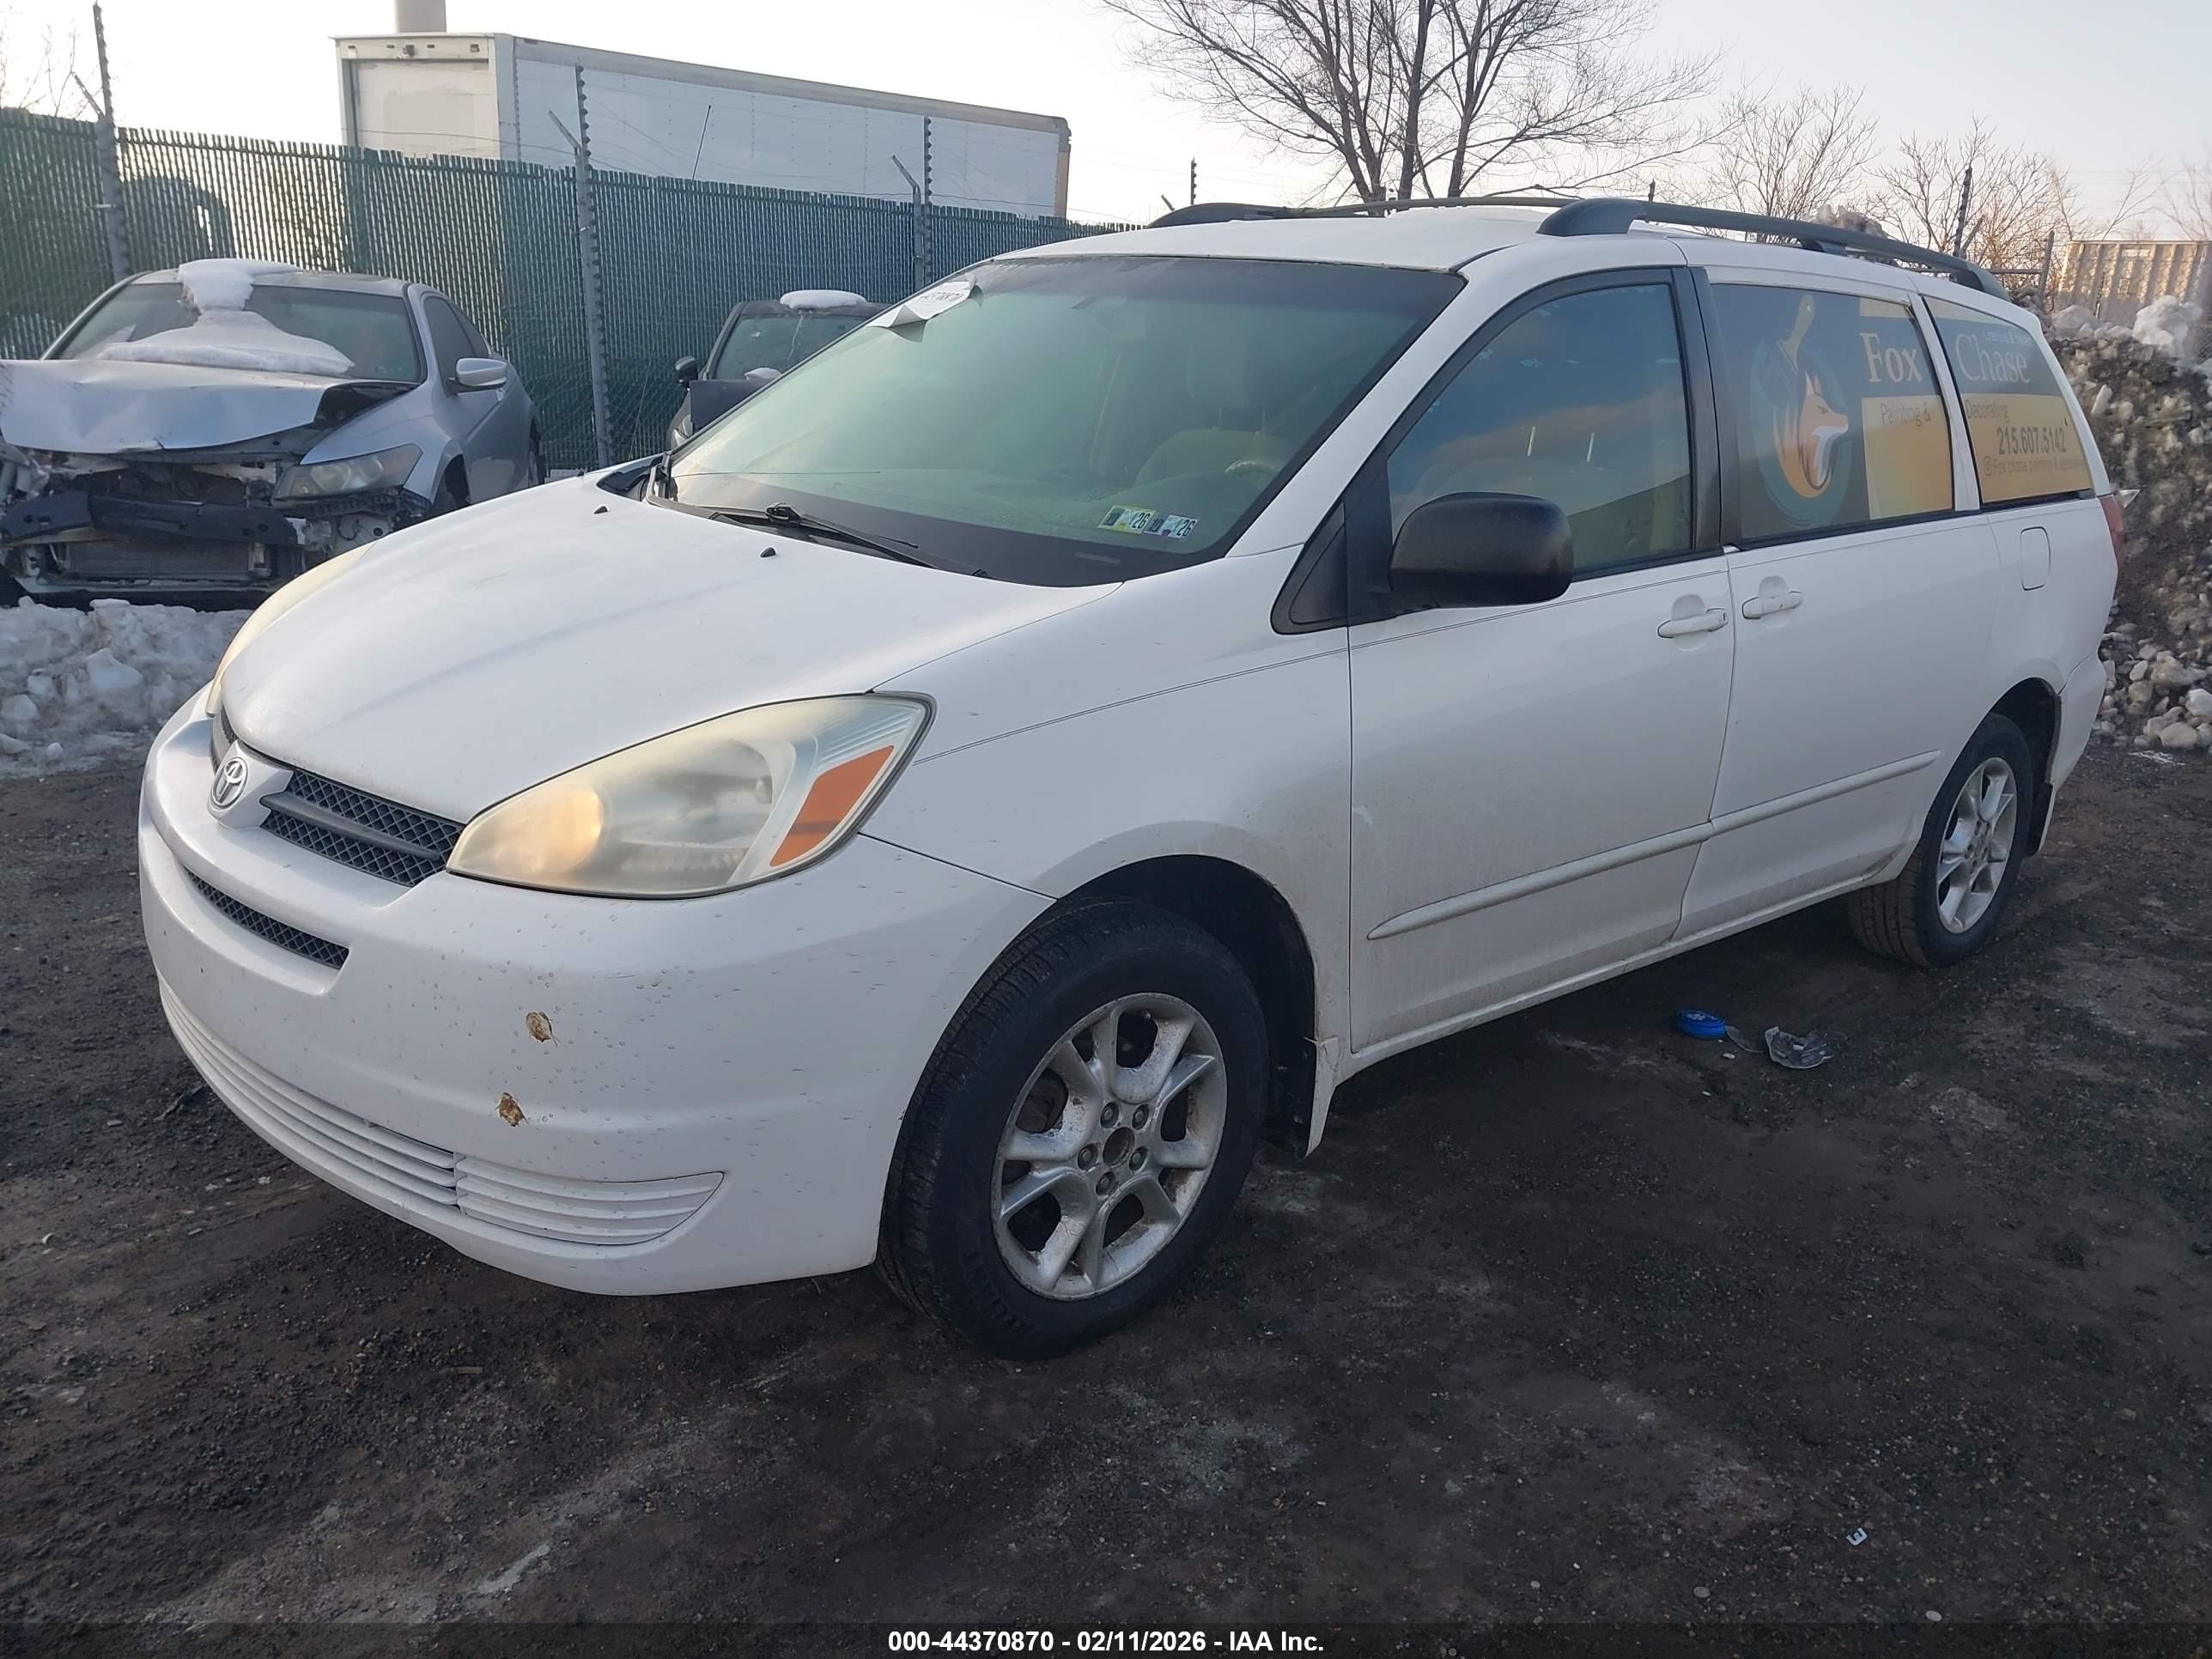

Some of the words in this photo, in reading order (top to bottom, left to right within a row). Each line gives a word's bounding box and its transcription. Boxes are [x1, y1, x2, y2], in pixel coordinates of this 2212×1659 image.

[1860, 332, 1923, 383] Fox
[1955, 333, 2031, 384] Chase
[1965, 399, 2009, 422] Decorating
[1997, 427, 2067, 455] 215.607.5142
